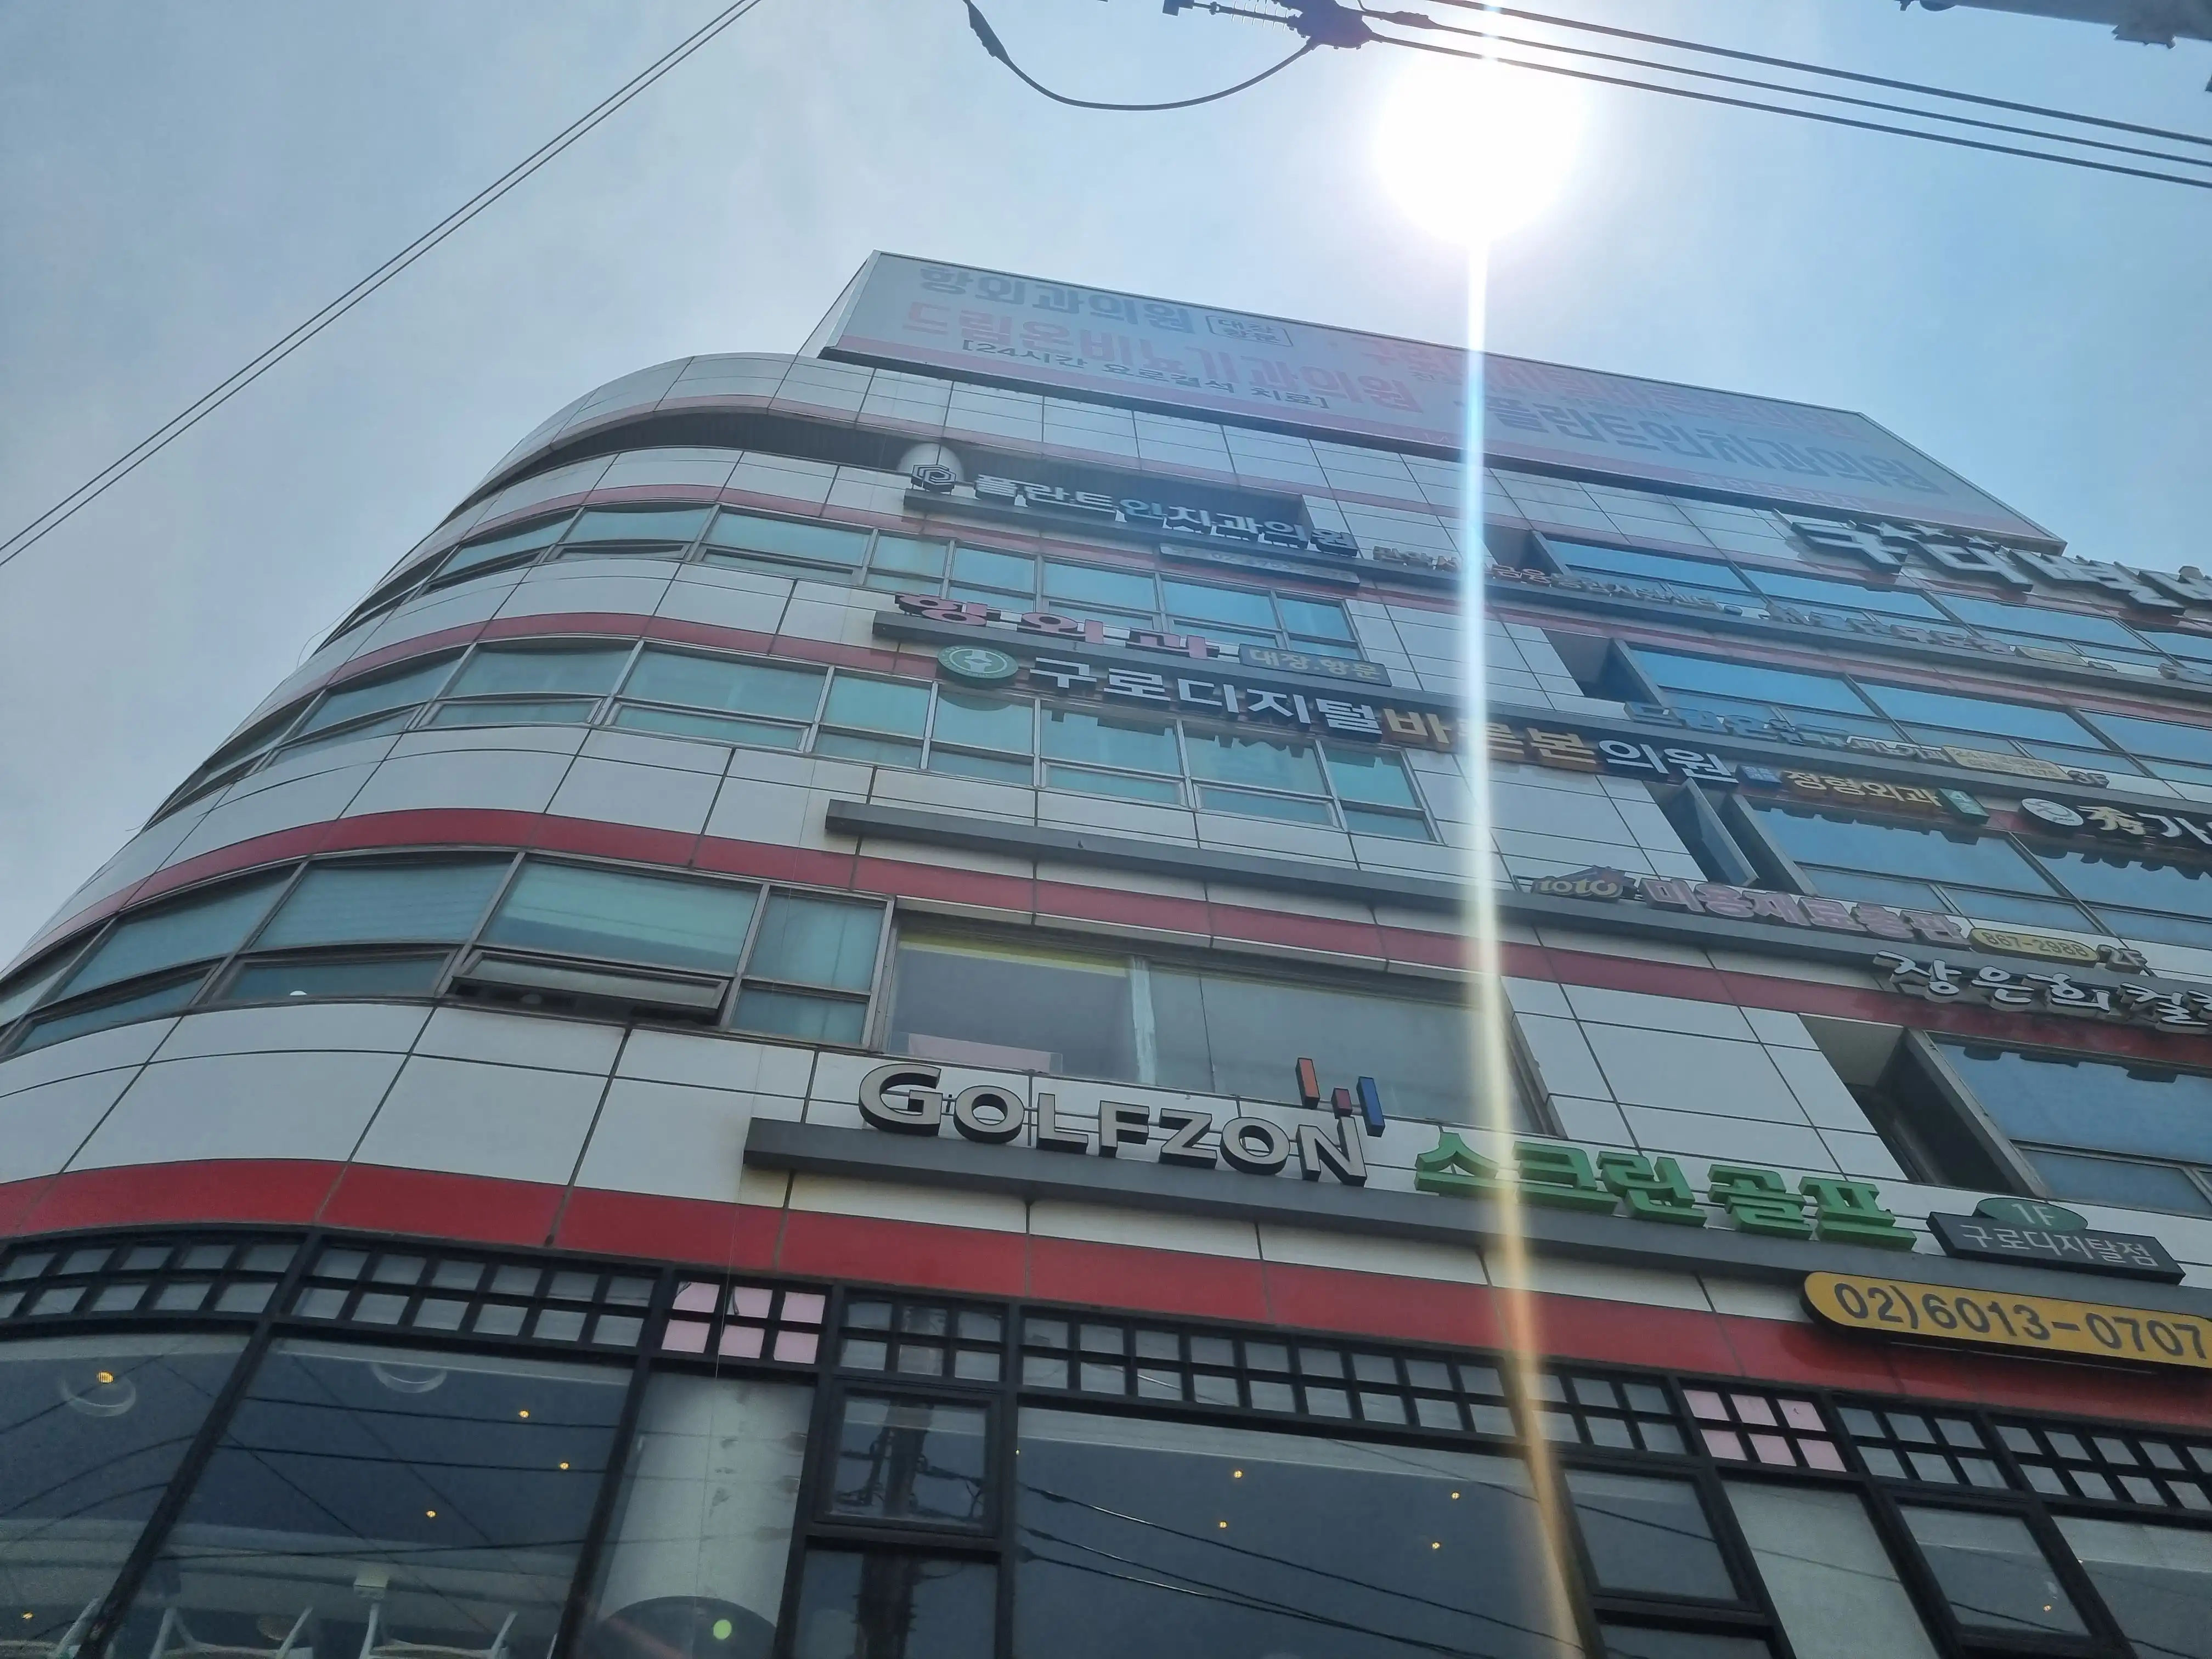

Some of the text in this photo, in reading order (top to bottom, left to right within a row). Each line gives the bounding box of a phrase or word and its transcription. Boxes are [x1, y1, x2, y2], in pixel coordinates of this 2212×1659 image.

[913, 264, 1197, 335] 항외과의원
[901, 301, 1425, 414] 드림온비뇨기과의원
[961, 340, 1331, 409] [24시간 요로결석 치료]
[1476, 392, 1956, 498] 플란트인치과의원
[975, 474, 1358, 554] 플란트인치과의원
[895, 593, 1219, 658] 항외과
[1784, 771, 1942, 806] 정형외과
[1980, 932, 2089, 957] 867-2988
[859, 1063, 1367, 1186] GOLFZON
[1959, 1224, 2159, 1267] 구로디지탈점
[2011, 1203, 2056, 1227] 1F
[1832, 1283, 2207, 1359] 02)6013-0707
